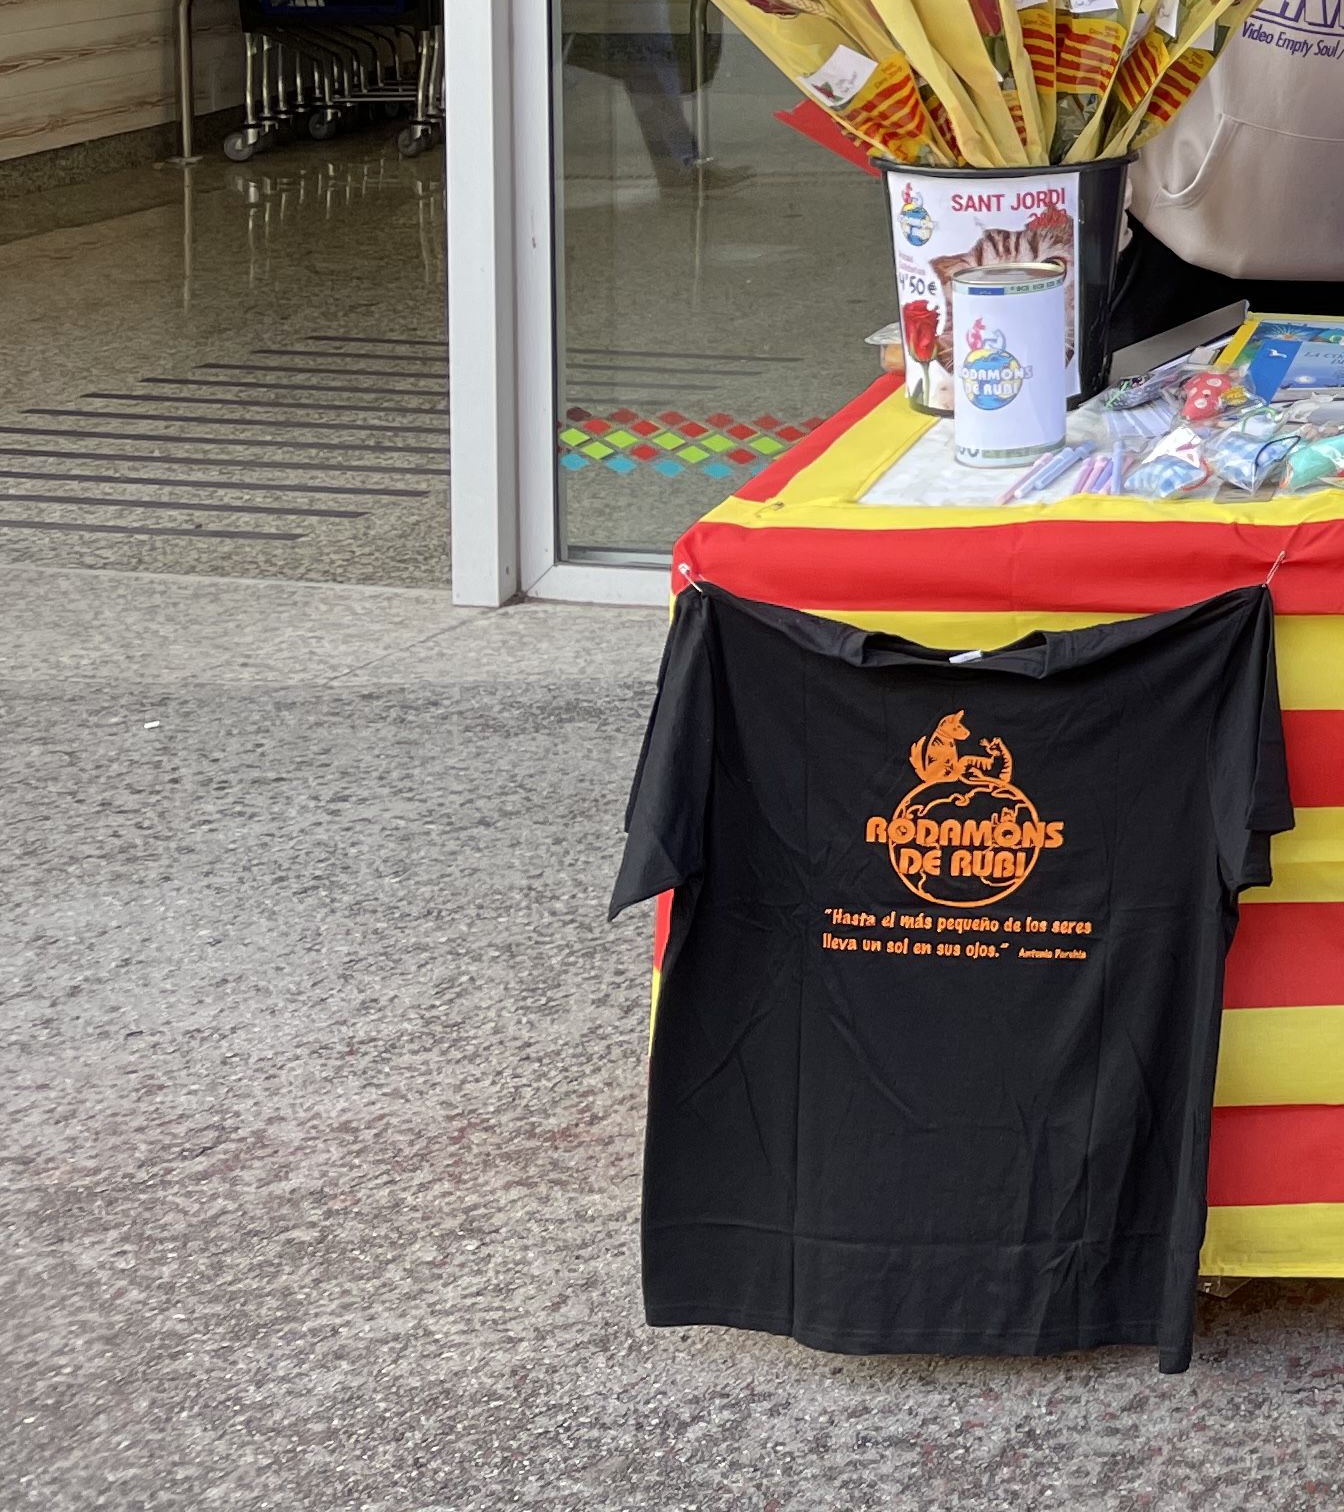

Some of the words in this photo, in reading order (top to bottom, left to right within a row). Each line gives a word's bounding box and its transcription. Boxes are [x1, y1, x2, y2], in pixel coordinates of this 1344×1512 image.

[1241, 21, 1274, 44] Video
[1276, 32, 1311, 58] Empty
[1314, 40, 1337, 57] Soul
[952, 194, 1005, 212] SANT
[1011, 188, 1065, 211] JORDI
[866, 817, 1065, 848] RODAMONS
[899, 848, 942, 875] DE
[881, 911, 895, 928] el
[900, 913, 932, 930] más
[937, 915, 999, 934] pequeño
[1003, 917, 1022, 933] de
[1025, 917, 1047, 933] los
[1051, 919, 1092, 934] seres
[823, 933, 857, 951] lleva
[863, 939, 881, 952] un
[886, 937, 909, 955] sol
[913, 941, 932, 955] en
[936, 943, 960, 957] sus
